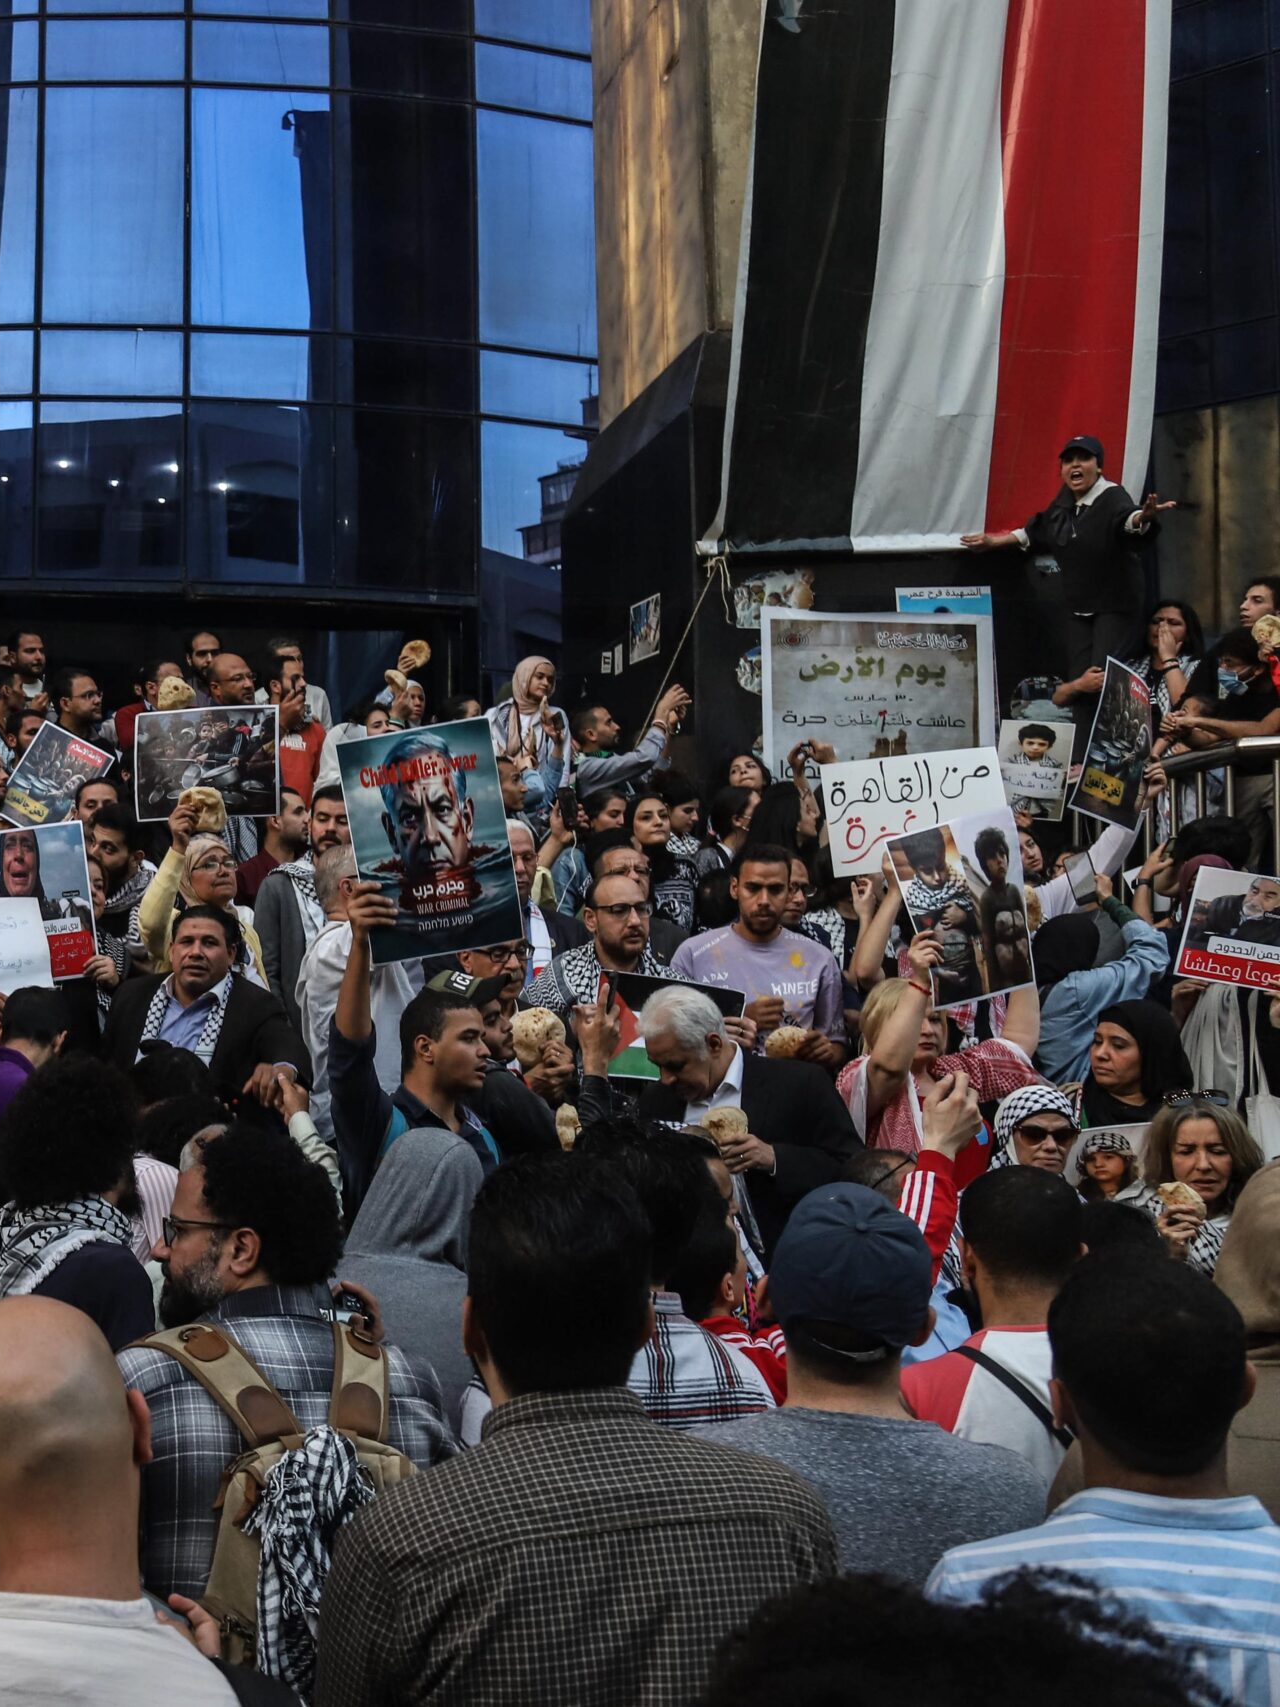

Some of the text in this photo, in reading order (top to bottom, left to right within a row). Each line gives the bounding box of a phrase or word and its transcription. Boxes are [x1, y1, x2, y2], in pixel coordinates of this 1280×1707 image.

[799, 646, 946, 688] يوم الأرض
[782, 710, 827, 727] حرة
[916, 714, 966, 728] عاشت
[359, 763, 399, 789] Child
[940, 765, 991, 799] من
[829, 759, 932, 825] القاهرة
[412, 880, 465, 900] مجرم حرب
[416, 896, 470, 915] WAR CRIMINAL
[418, 914, 474, 931] פושע מלחמה
[1214, 943, 1257, 957] الدحدوح
